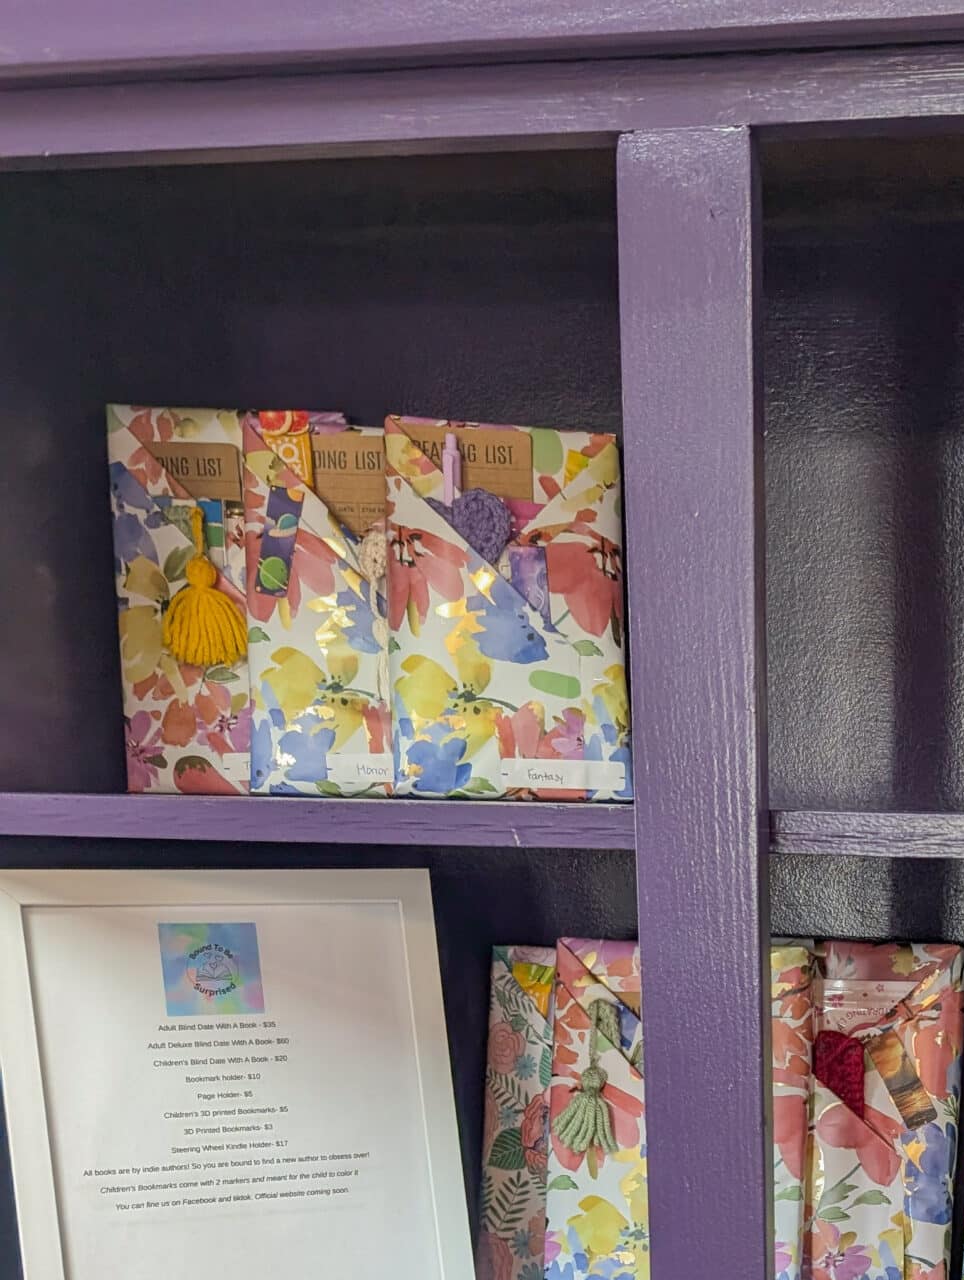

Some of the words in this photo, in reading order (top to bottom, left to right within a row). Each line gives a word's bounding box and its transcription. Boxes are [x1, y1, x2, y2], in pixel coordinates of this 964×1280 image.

[313, 450, 347, 470] DING
[355, 451, 381, 470] LIST
[485, 445, 514, 465] LIST
[196, 457, 224, 477] LIST
[527, 768, 564, 784] Fantasy
[193, 981, 236, 997] Surprised
[185, 1075, 220, 1083] Bookmark
[212, 1108, 236, 1117] printed
[195, 1126, 220, 1135] Printed
[171, 1145, 201, 1154] Steering
[202, 1143, 225, 1152] Wheel
[226, 1142, 247, 1151] Kindle
[94, 1168, 117, 1176] books
[131, 1165, 141, 1175] by
[142, 1165, 160, 1173] indie
[202, 1162, 216, 1170] you
[230, 1159, 253, 1167] bound
[138, 1182, 178, 1191] Bookmarks
[200, 1178, 214, 1187] with
[222, 1177, 250, 1185] markers
[252, 1175, 265, 1183] and
[311, 1170, 327, 1179] child
[336, 1169, 353, 1177] color
[115, 1203, 130, 1211] You
[183, 1196, 217, 1205] Facebook
[280, 1189, 305, 1197] website
[306, 1187, 331, 1196] coming
